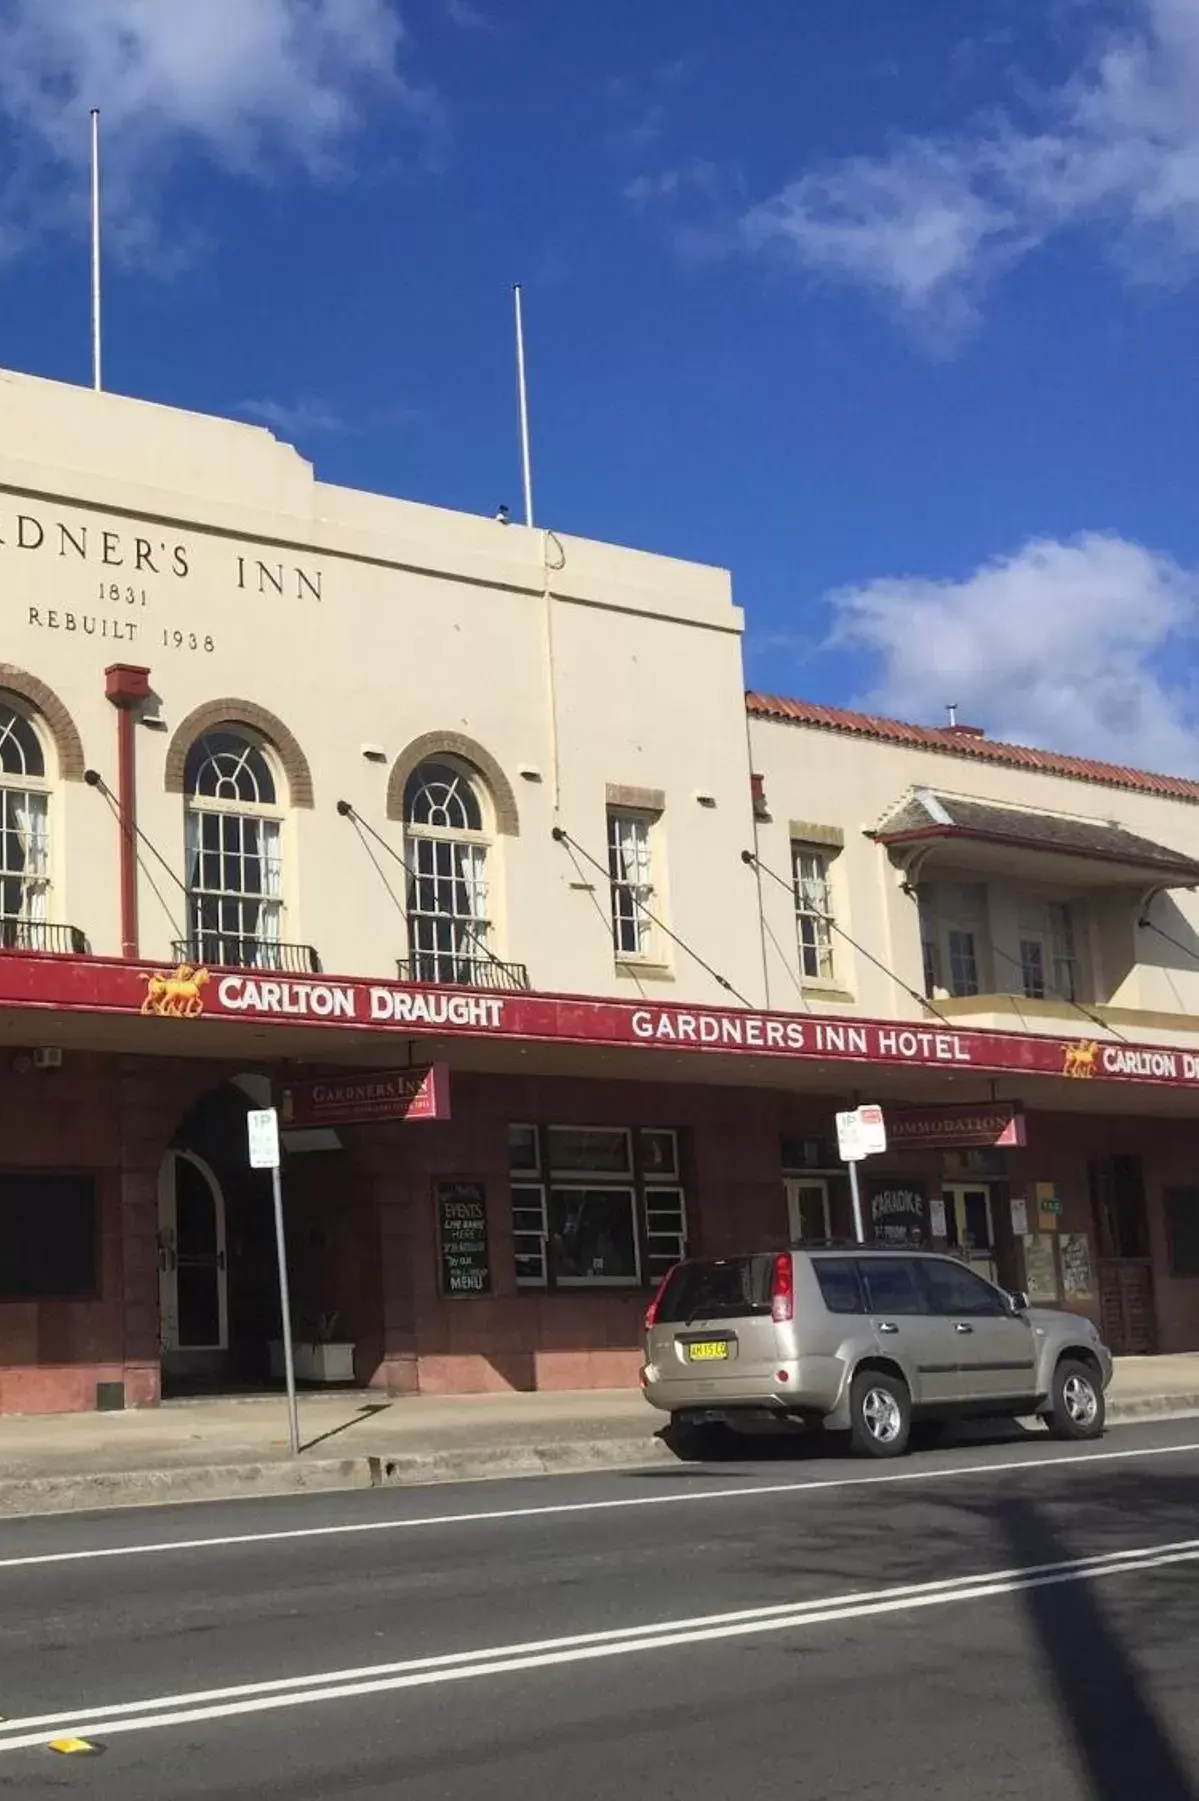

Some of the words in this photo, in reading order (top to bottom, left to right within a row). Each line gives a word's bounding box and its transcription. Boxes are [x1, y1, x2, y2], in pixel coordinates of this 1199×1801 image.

[98, 582, 147, 607] 1831
[237, 556, 323, 602] INN
[28, 606, 138, 642] REBUILT
[162, 629, 216, 654] 1938
[218, 975, 356, 1017] CARLTON
[369, 986, 504, 1027] DRAUGHT
[632, 1011, 805, 1049] GARDNERS
[815, 1025, 868, 1053] INN
[878, 1030, 971, 1060] HOTEL
[1102, 1046, 1177, 1076] CARLTON
